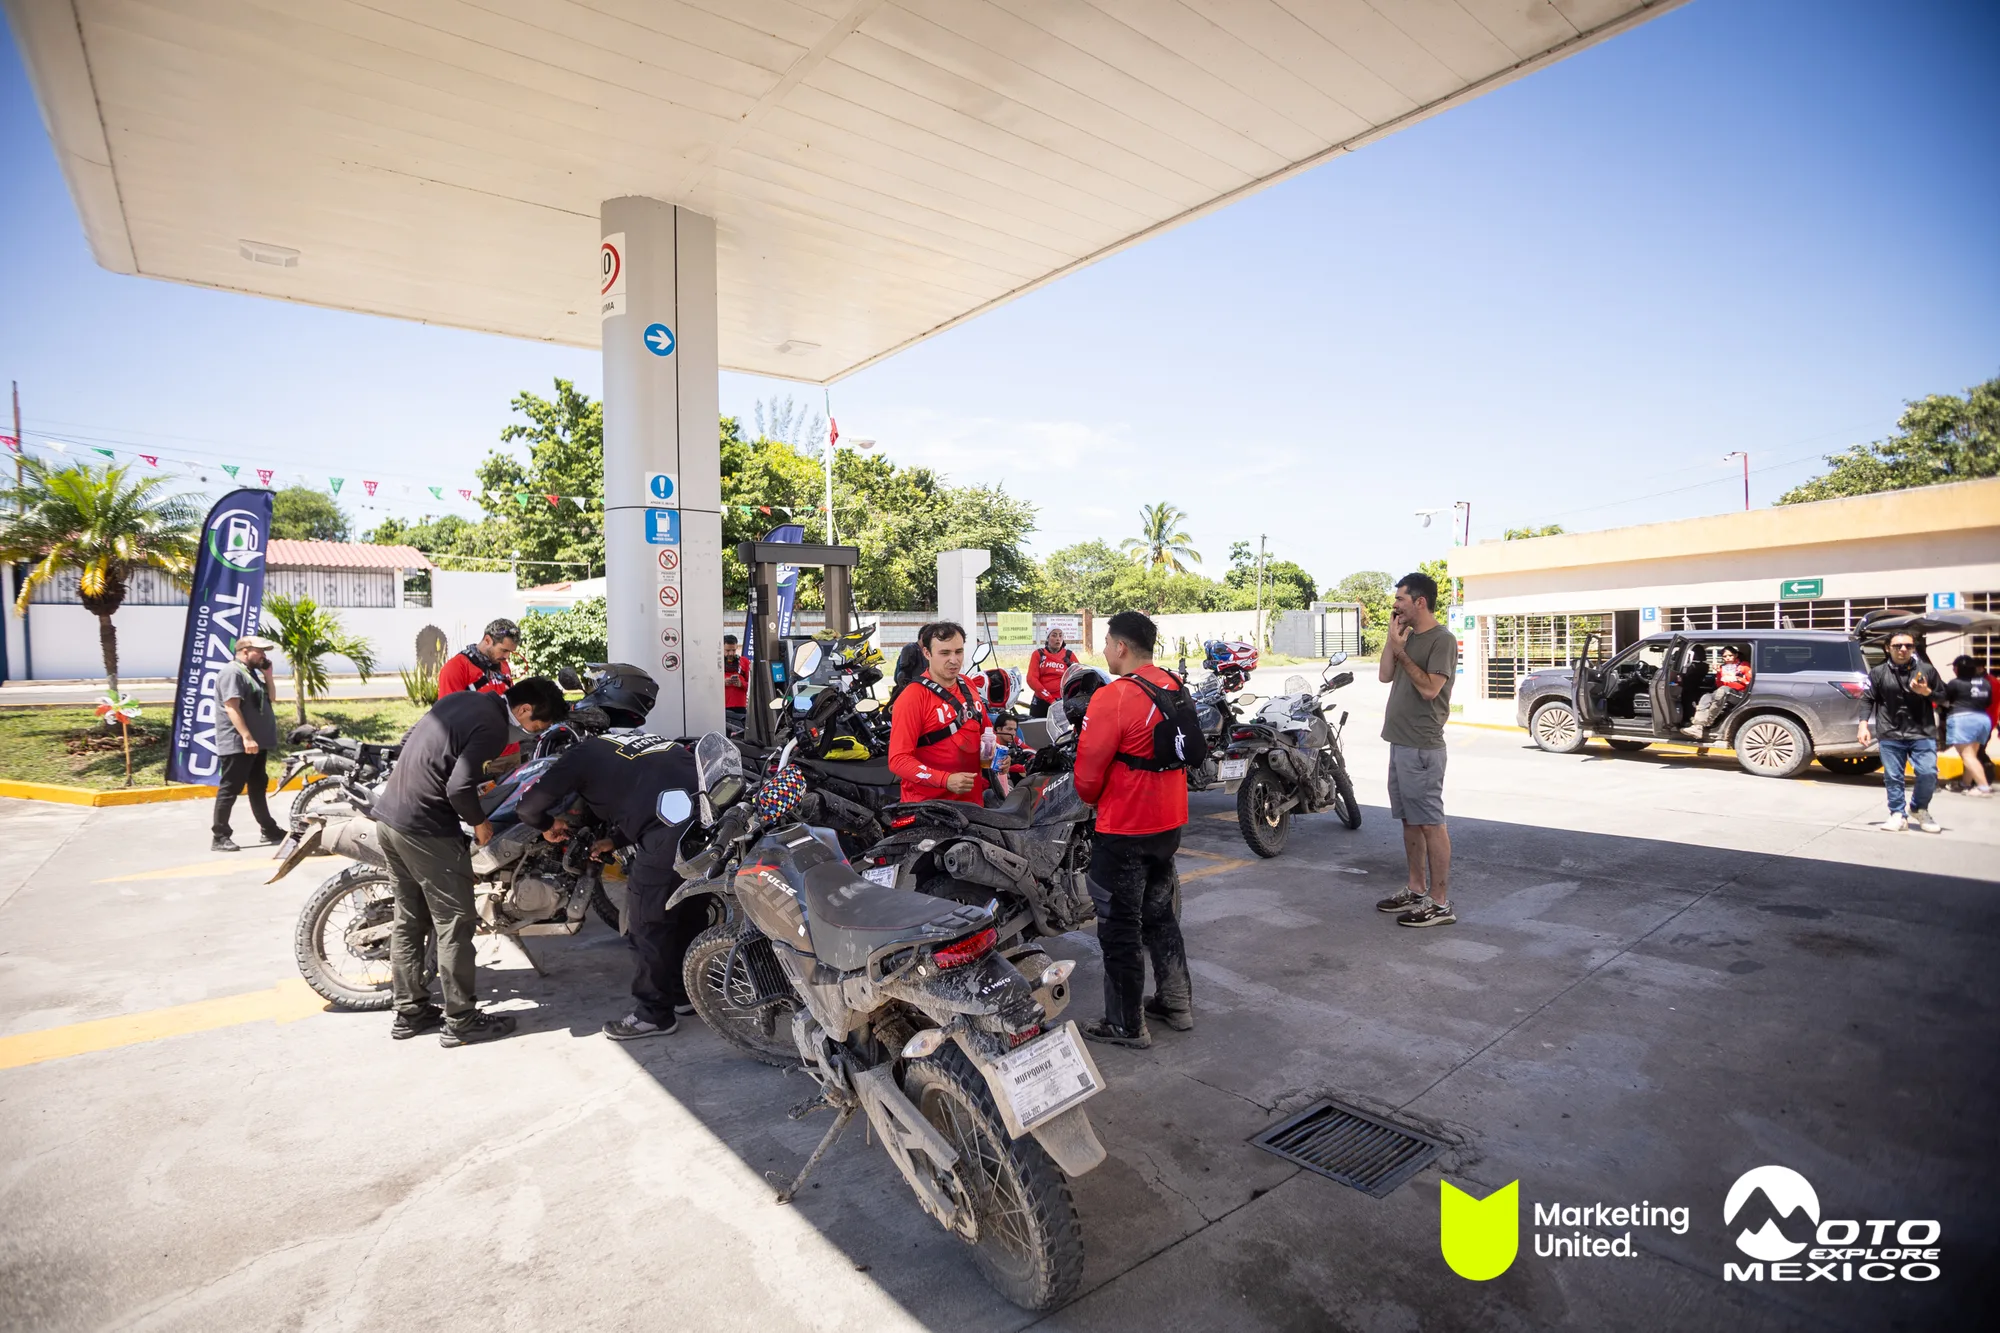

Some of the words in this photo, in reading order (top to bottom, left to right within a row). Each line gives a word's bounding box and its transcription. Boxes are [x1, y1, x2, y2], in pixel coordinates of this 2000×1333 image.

[1938, 594, 1950, 608] E
[1645, 608, 1653, 619] E
[192, 605, 210, 664] SERVICIO
[188, 668, 201, 685] DE
[178, 687, 197, 748] ESTACIÓN
